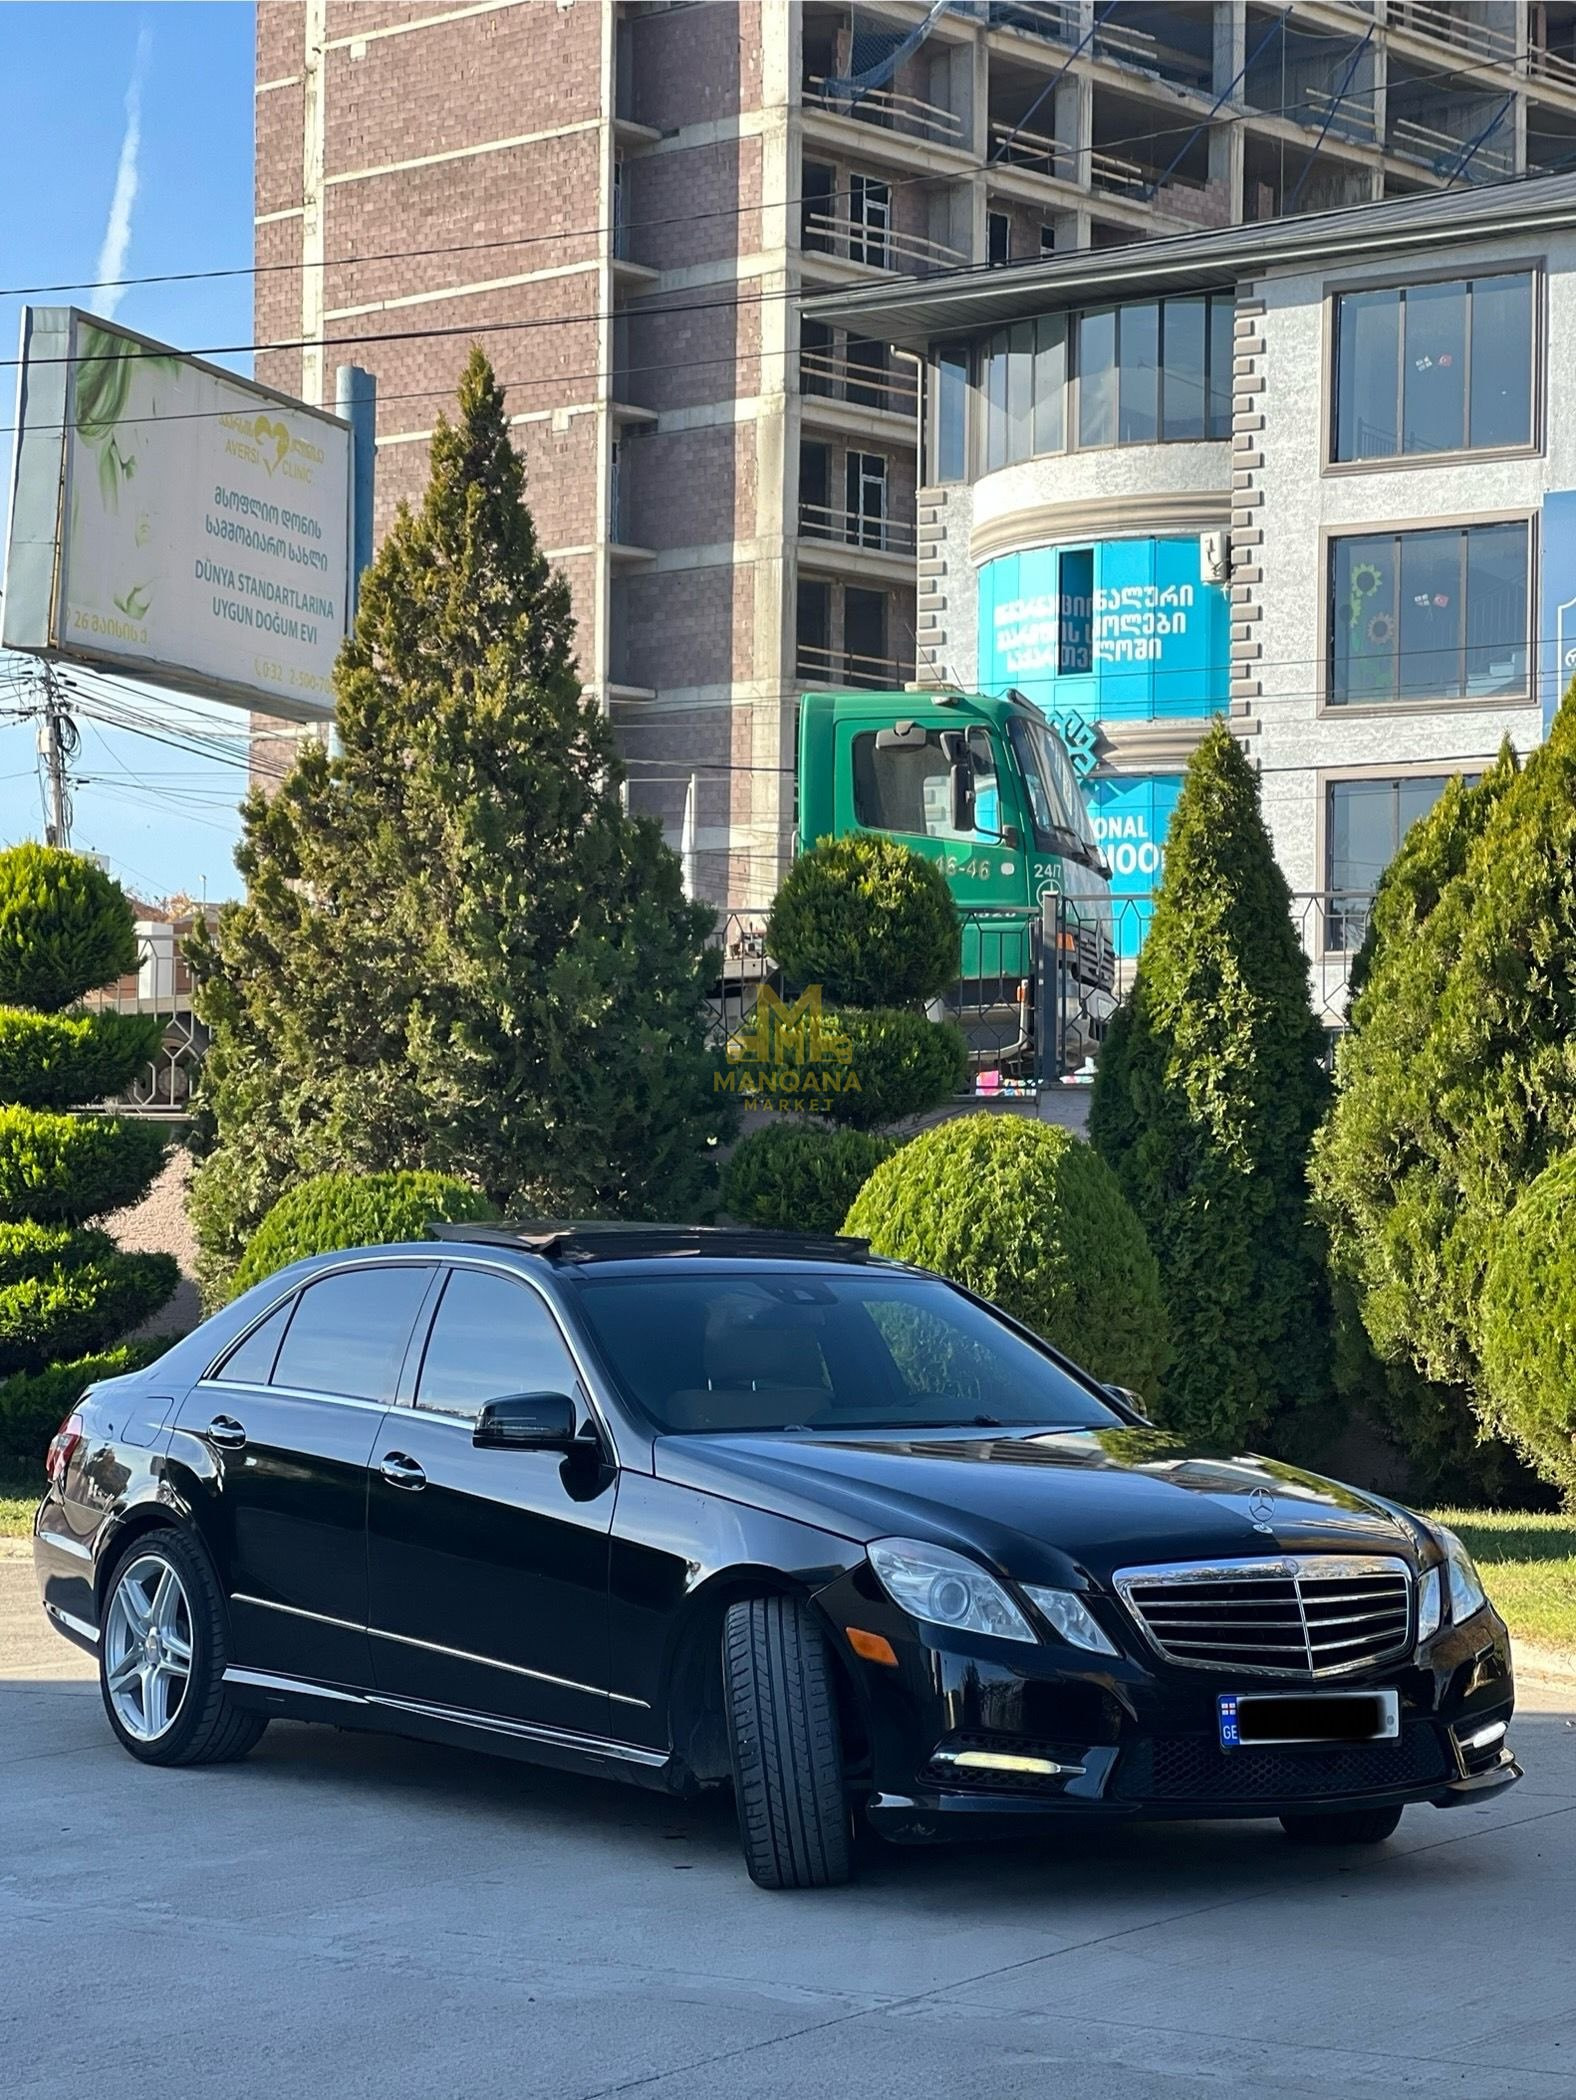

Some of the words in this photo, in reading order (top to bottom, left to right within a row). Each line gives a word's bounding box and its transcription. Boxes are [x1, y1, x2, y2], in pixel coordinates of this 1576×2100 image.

[224, 439, 260, 464] AVERSI
[282, 460, 312, 484] CLINIC
[214, 486, 279, 525] მსოფლიო
[281, 509, 321, 539] დონის
[205, 513, 286, 559] სამშობიარო
[288, 542, 328, 571] სახლი
[195, 558, 235, 589] DÜNYA
[238, 573, 334, 619] STANDARTLARINA
[74, 611, 89, 630] 26
[212, 597, 253, 626] UYGUN
[255, 610, 298, 639] DOĞUM
[1222, 1725, 1238, 1740] GE
